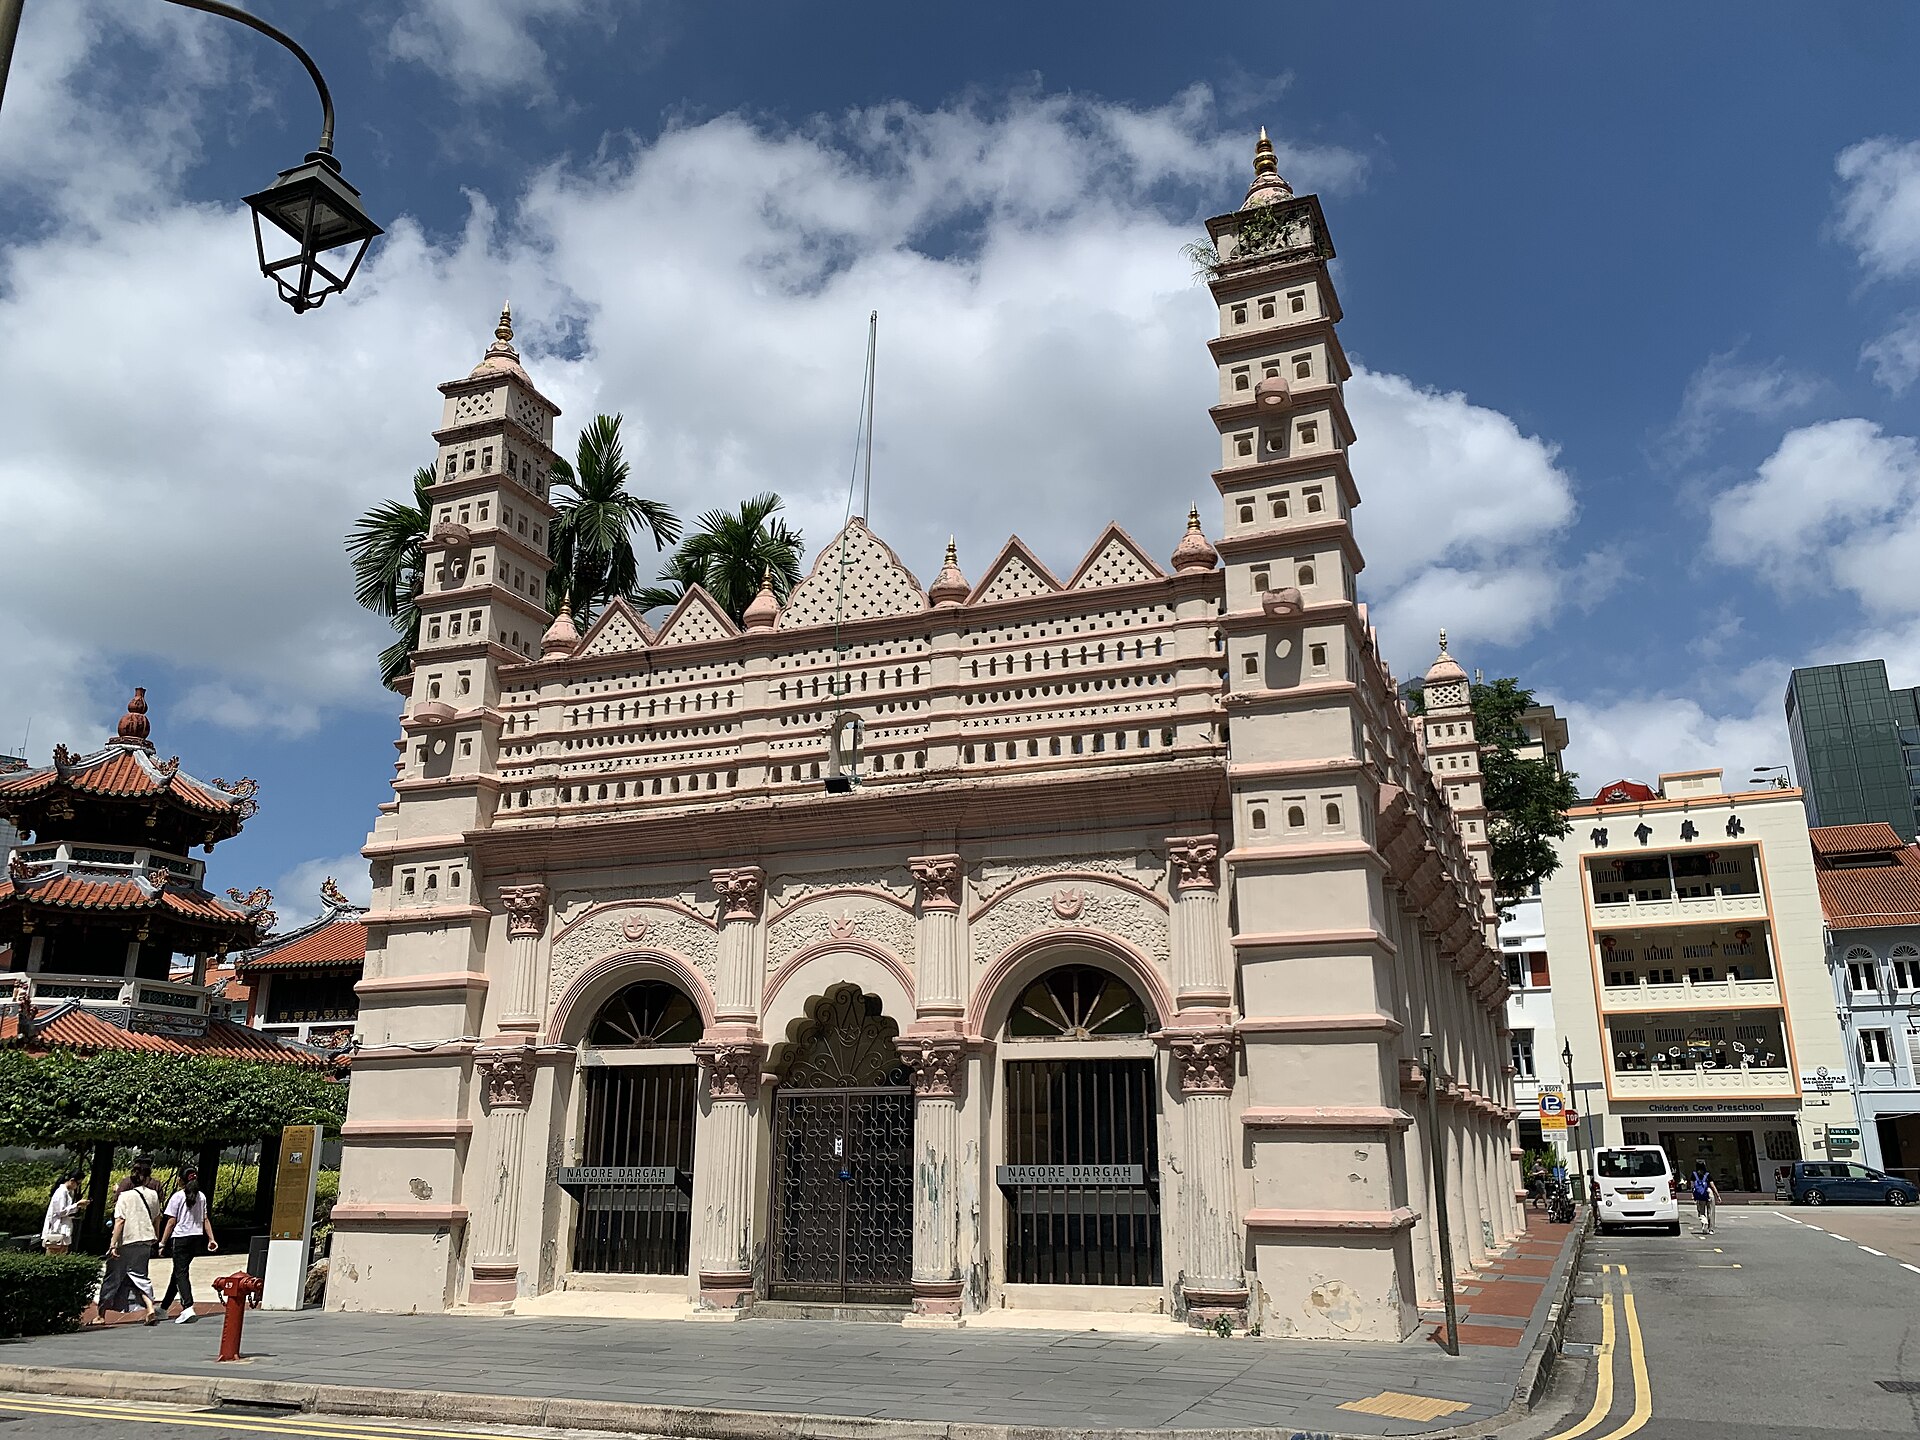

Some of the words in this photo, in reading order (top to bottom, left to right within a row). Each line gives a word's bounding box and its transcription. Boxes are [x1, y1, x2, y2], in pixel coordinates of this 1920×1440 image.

[1648, 1104, 1689, 1112] Children's
[1692, 1104, 1713, 1112] Cove
[1717, 1103, 1764, 1111] Preschool
[567, 1168, 613, 1178] NAGORE
[618, 1168, 666, 1178] DARGAH
[1008, 1167, 1065, 1177] NAGORE
[1072, 1167, 1131, 1177] DARGAH
